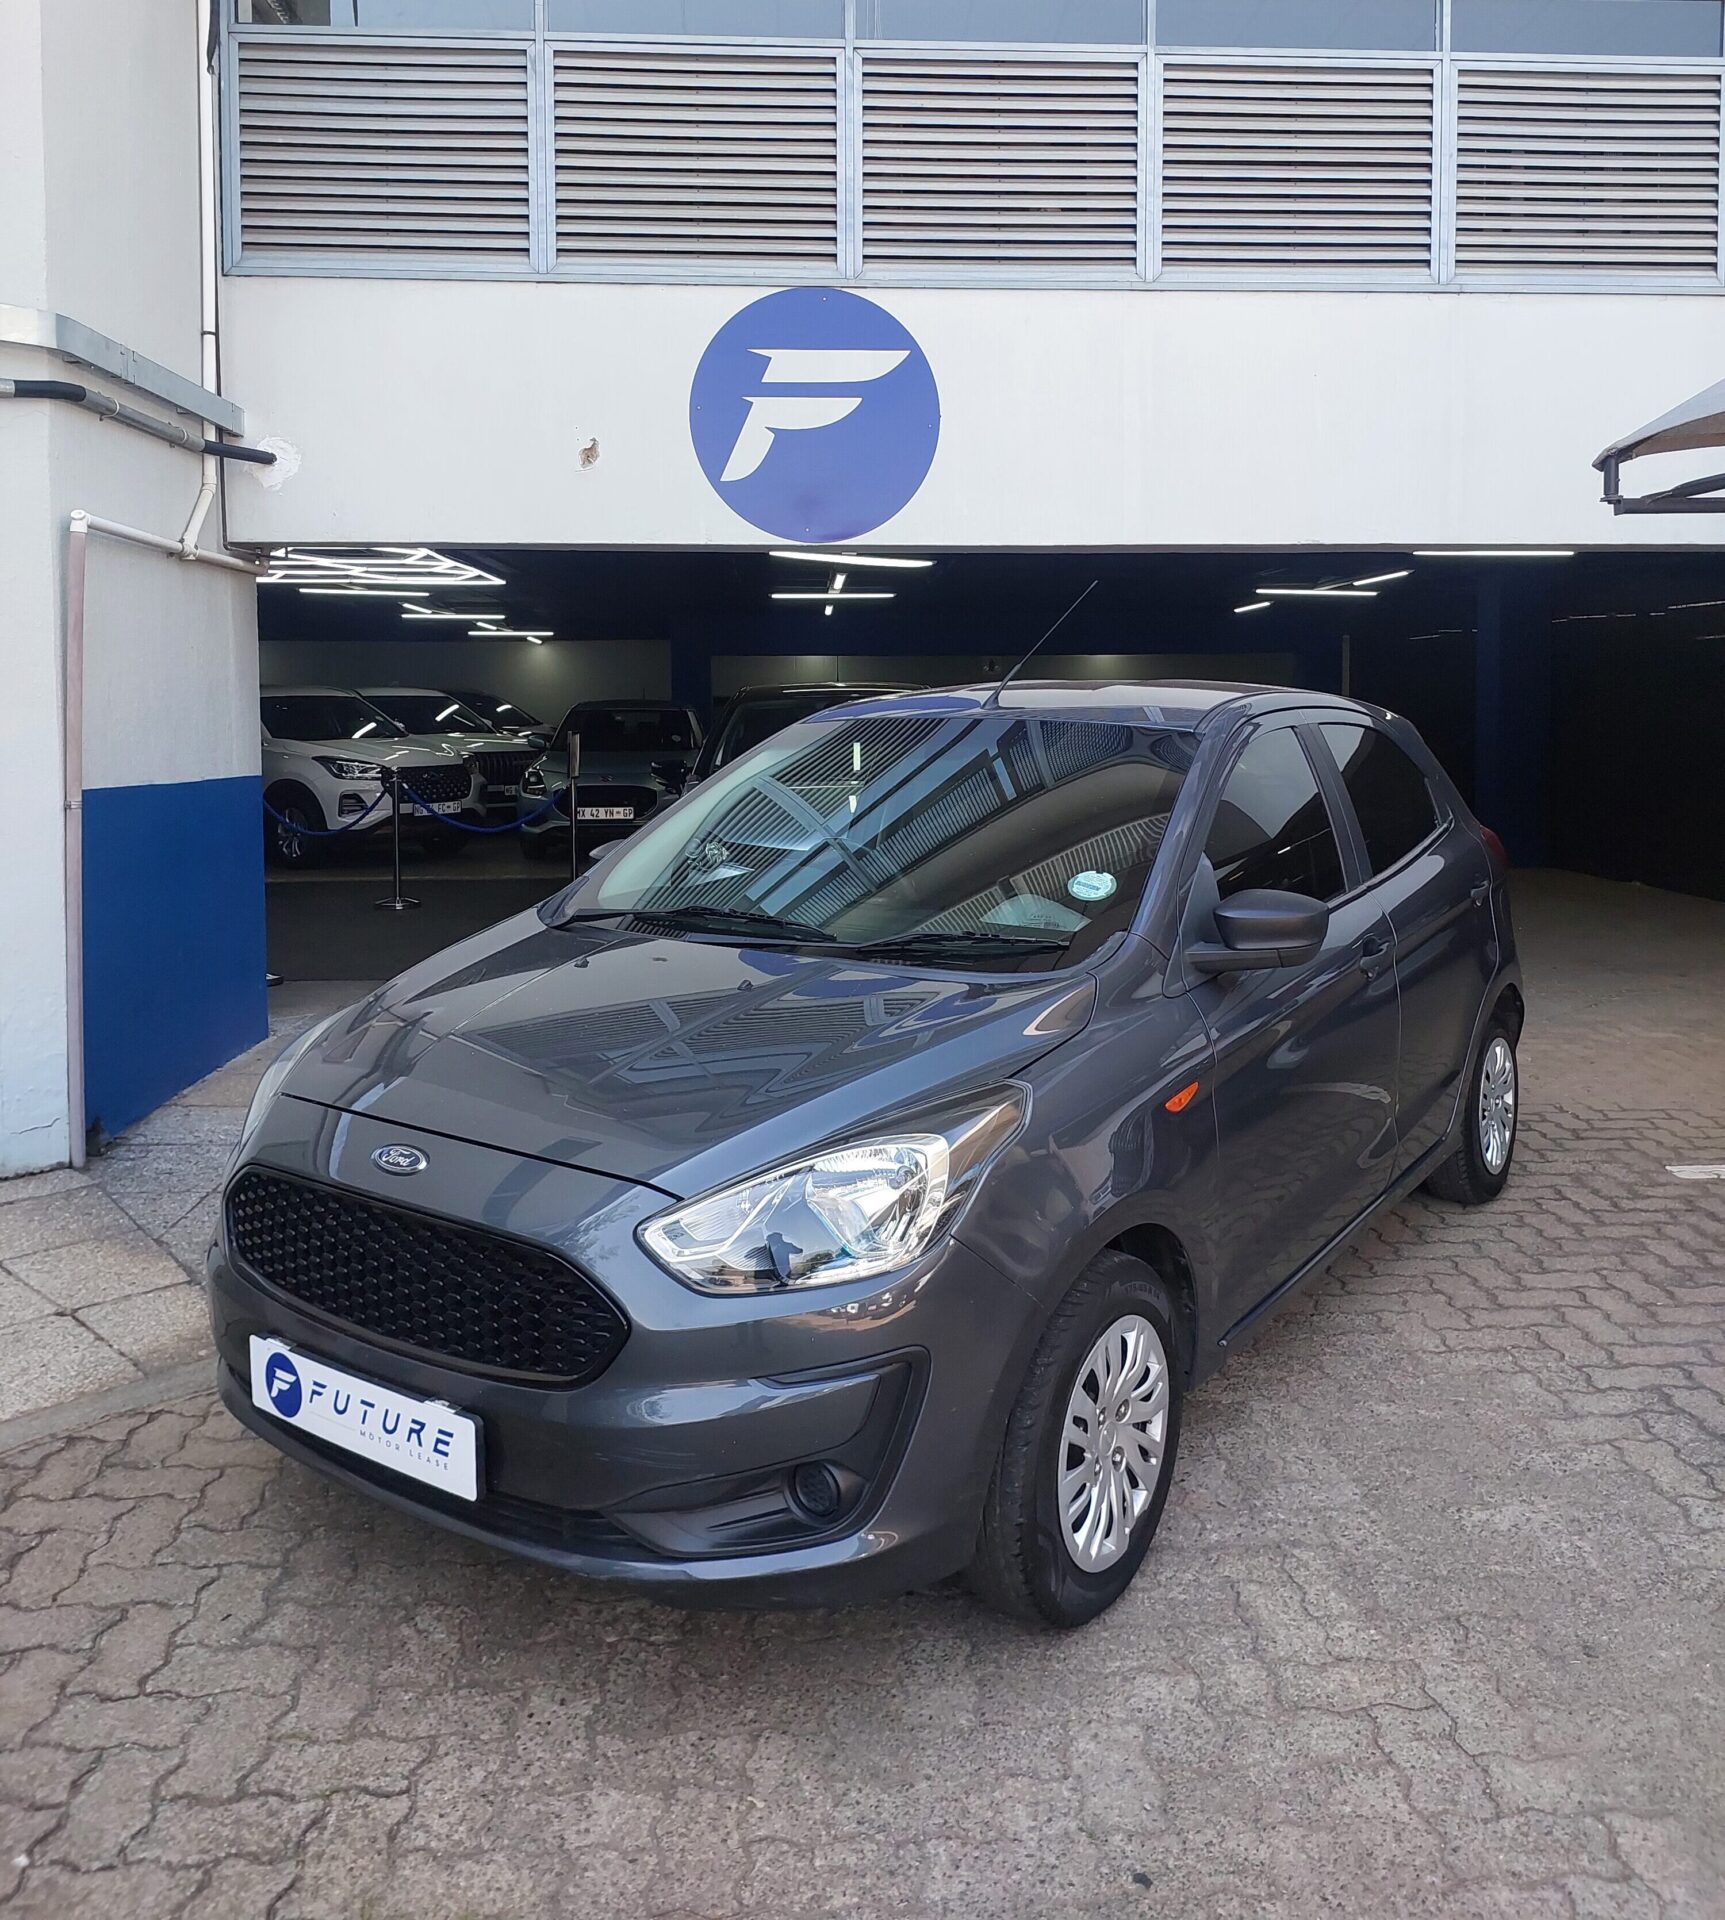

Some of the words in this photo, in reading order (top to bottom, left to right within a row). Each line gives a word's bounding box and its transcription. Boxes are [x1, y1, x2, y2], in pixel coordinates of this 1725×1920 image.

[590, 808, 600, 819] 42
[381, 1148, 416, 1167] Ford
[308, 1379, 455, 1458] FUTURE
[360, 1429, 400, 1451] MOTOR
[409, 1449, 449, 1471] LEASE
